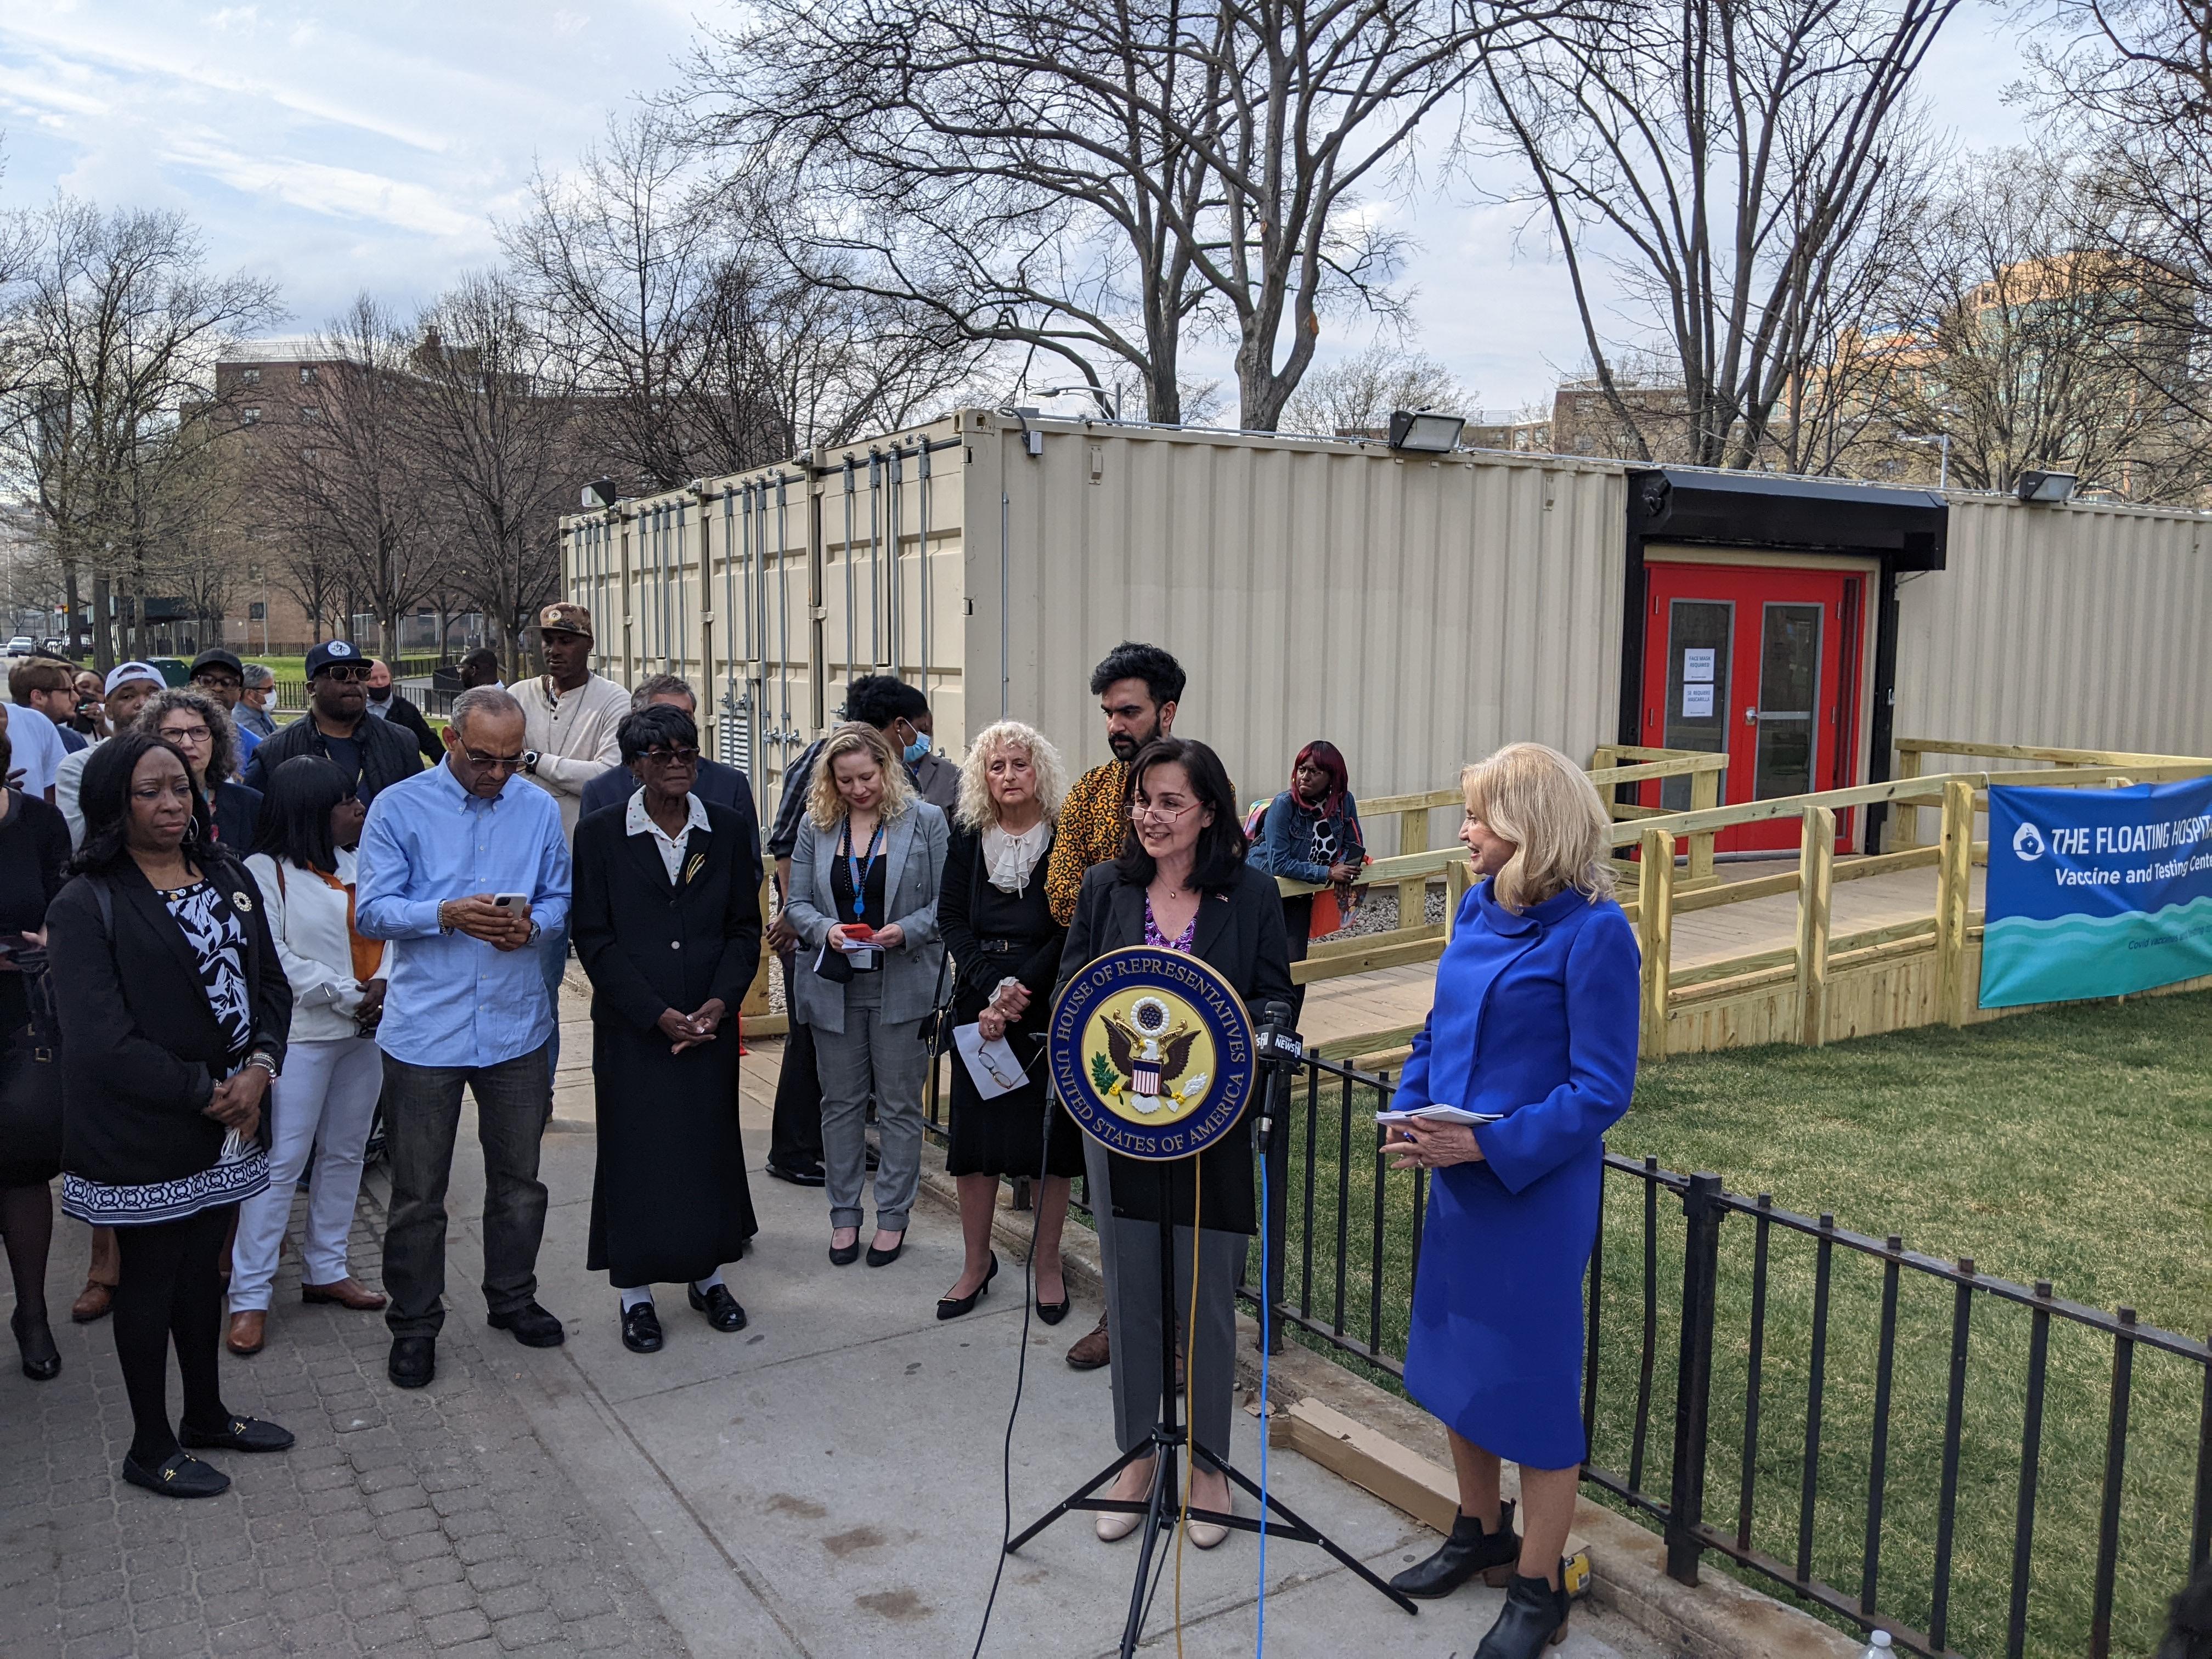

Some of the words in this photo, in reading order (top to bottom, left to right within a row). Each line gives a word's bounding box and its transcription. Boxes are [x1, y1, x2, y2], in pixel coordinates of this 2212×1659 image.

[2051, 828, 2089, 854] THE
[2096, 822, 2170, 854] FLOATING
[2055, 867, 2120, 886] Vaccine
[2125, 864, 2152, 884] and
[2154, 859, 2189, 879] Testing
[2128, 936, 2149, 950] Covid
[1056, 981, 1093, 1042] HOUSE
[1092, 964, 1113, 986] OF
[1115, 958, 1245, 1063] REPRESENTATIVES
[1274, 1037, 1295, 1053] NEWS
[1277, 1034, 1293, 1042] SPECTRUM
[1056, 1048, 1094, 1120] UNITED
[1092, 1117, 1156, 1153] STATES
[1161, 1133, 1184, 1153] OF
[1189, 1071, 1244, 1146] AMERICA
